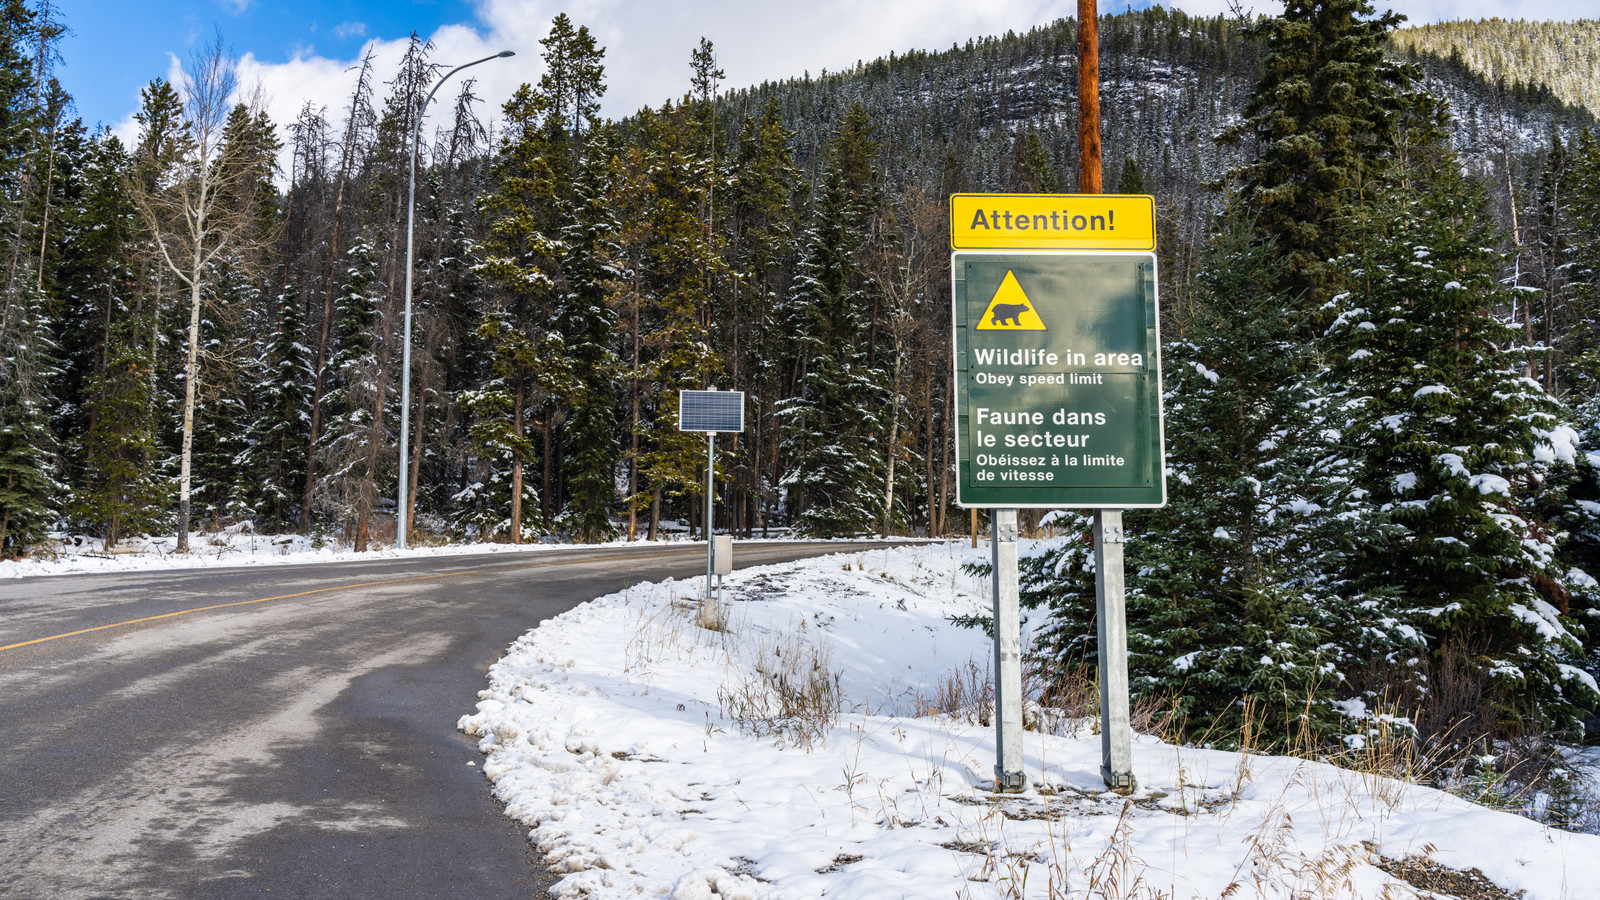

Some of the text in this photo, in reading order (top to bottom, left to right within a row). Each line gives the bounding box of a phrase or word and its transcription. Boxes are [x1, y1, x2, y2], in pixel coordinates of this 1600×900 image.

[970, 209, 1115, 231] Attention!
[974, 348, 1143, 366] Wildlife in area
[975, 373, 1103, 386] Obey speed limit
[977, 408, 1106, 425] Faune dans
[977, 430, 1090, 447] le secteur
[976, 454, 1125, 466] Obéissez à la limite
[976, 469, 1054, 481] de vitesse
